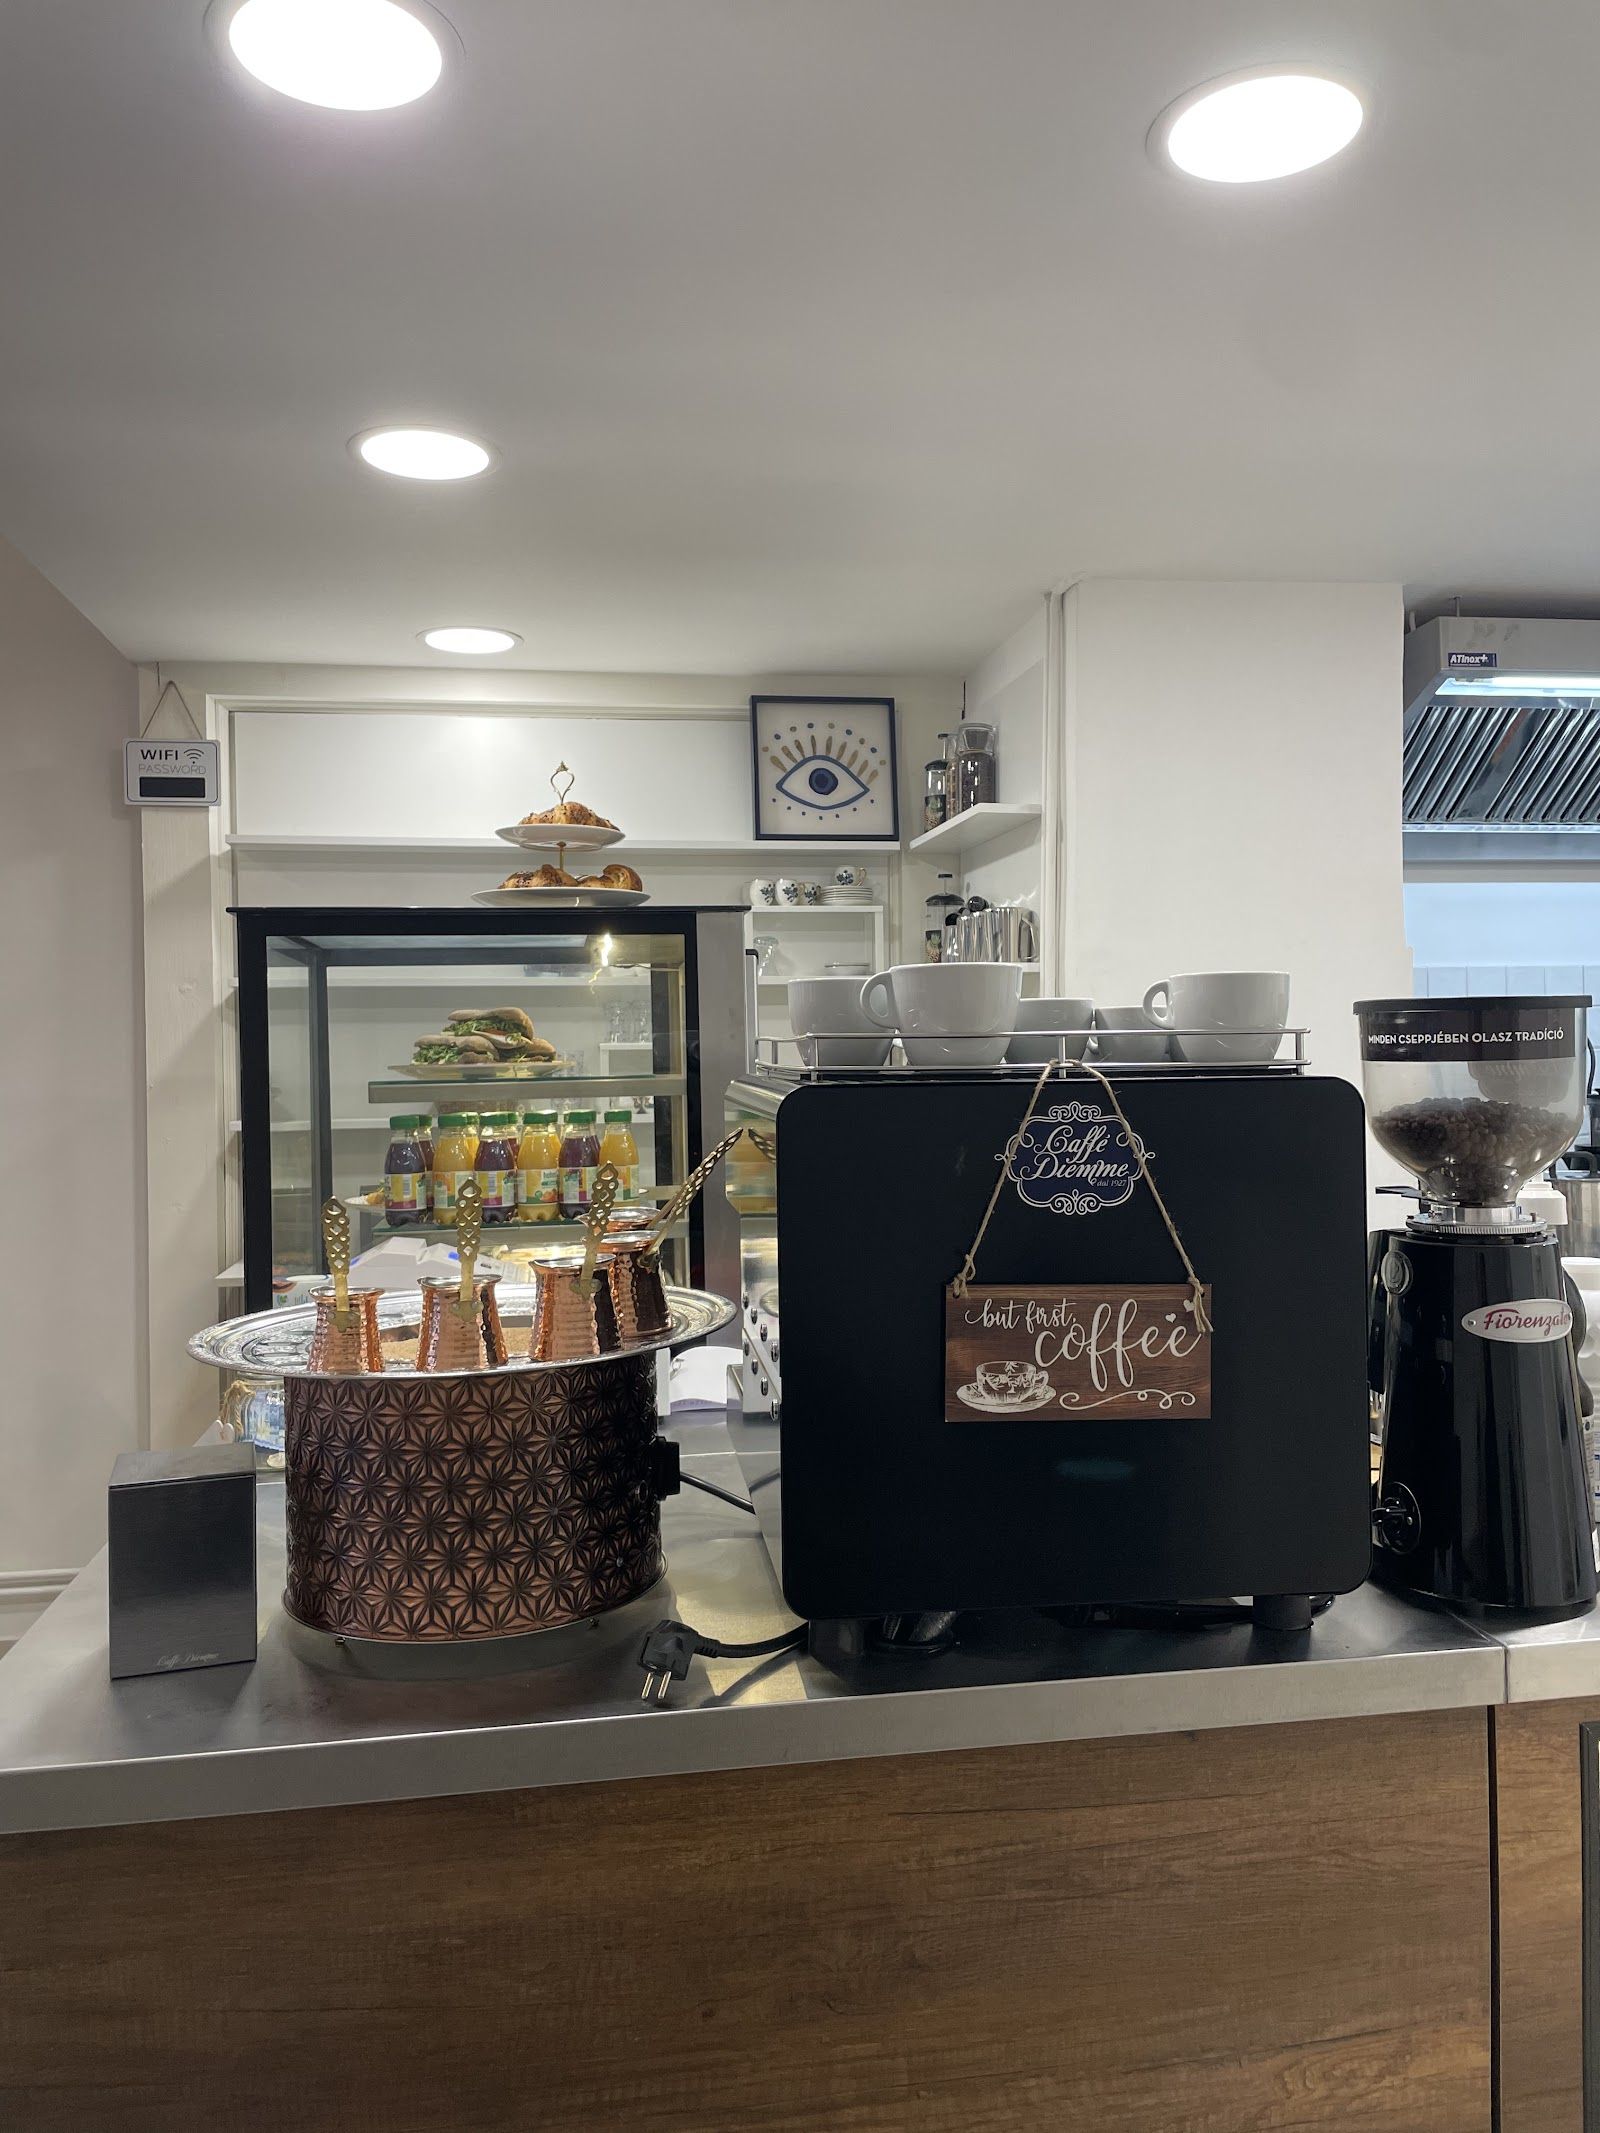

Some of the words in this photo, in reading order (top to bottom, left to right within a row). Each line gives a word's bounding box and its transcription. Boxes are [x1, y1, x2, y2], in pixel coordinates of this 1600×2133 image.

[140, 749, 179, 761] WIFI
[138, 763, 207, 775] PASSWORD
[1367, 1033, 1397, 1045] MINDEN
[1398, 1030, 1469, 1045] CSEPPJÉBEN
[1471, 1030, 1513, 1043] OLASZ
[1515, 1026, 1564, 1042] TRADÍCIÓ
[1020, 1151, 1130, 1187] Diemme
[1096, 1179, 1110, 1188] dal
[1110, 1178, 1128, 1188] 1927
[964, 1298, 1025, 1330] but
[1034, 1298, 1203, 1392] coffee
